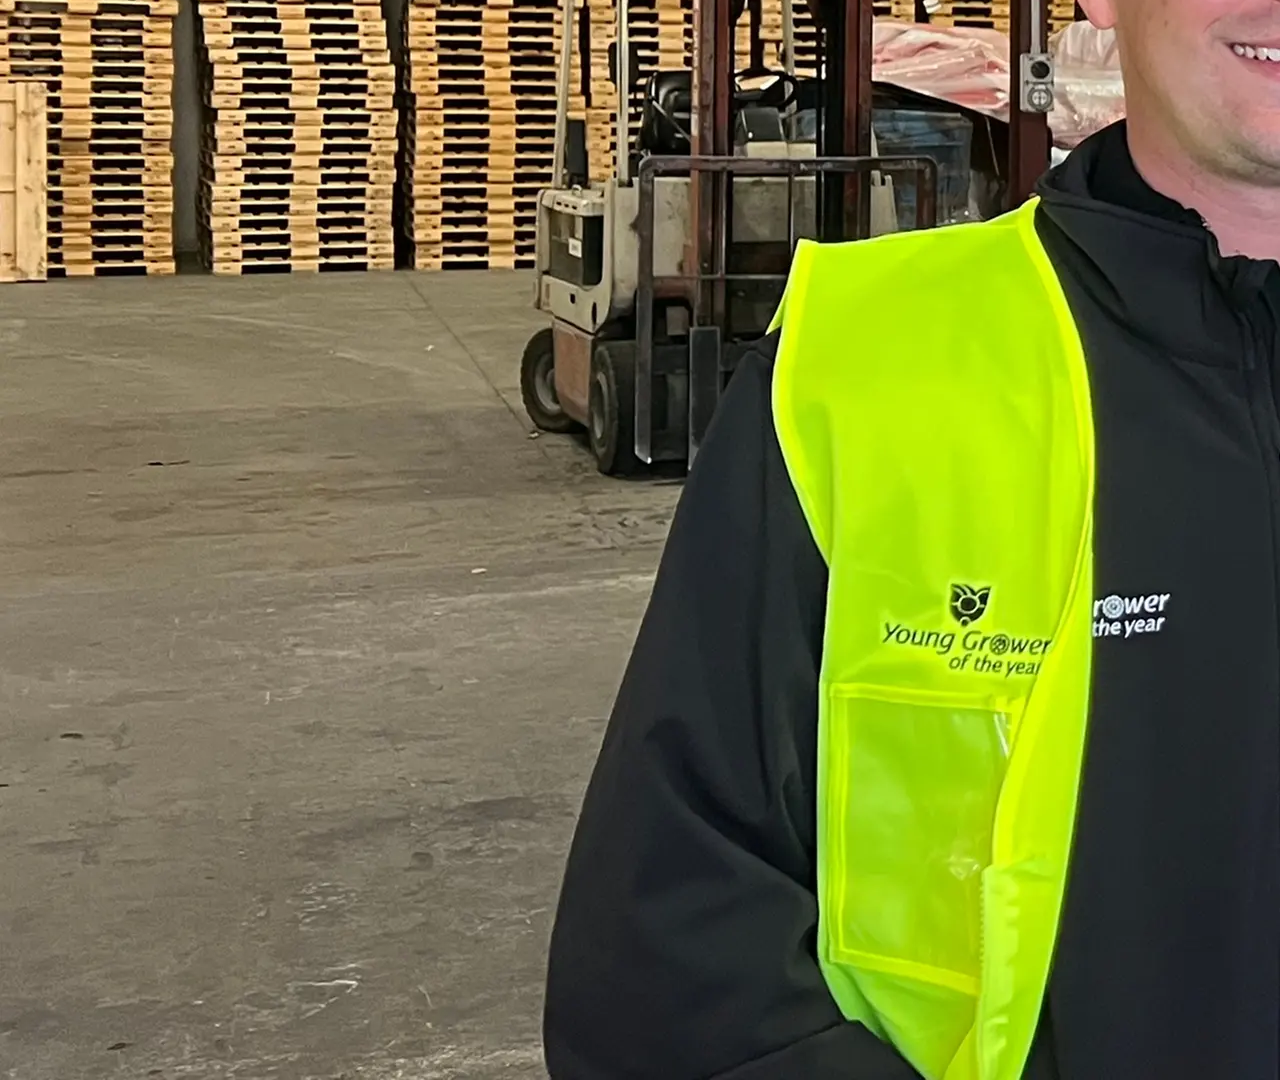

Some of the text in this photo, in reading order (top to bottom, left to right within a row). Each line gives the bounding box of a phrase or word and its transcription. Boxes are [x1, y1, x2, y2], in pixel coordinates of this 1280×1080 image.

[1093, 593, 1171, 619] rower
[882, 622, 1053, 656] Young Grower
[1092, 616, 1166, 639] the year
[949, 652, 973, 671] of
[973, 655, 1003, 674] the
